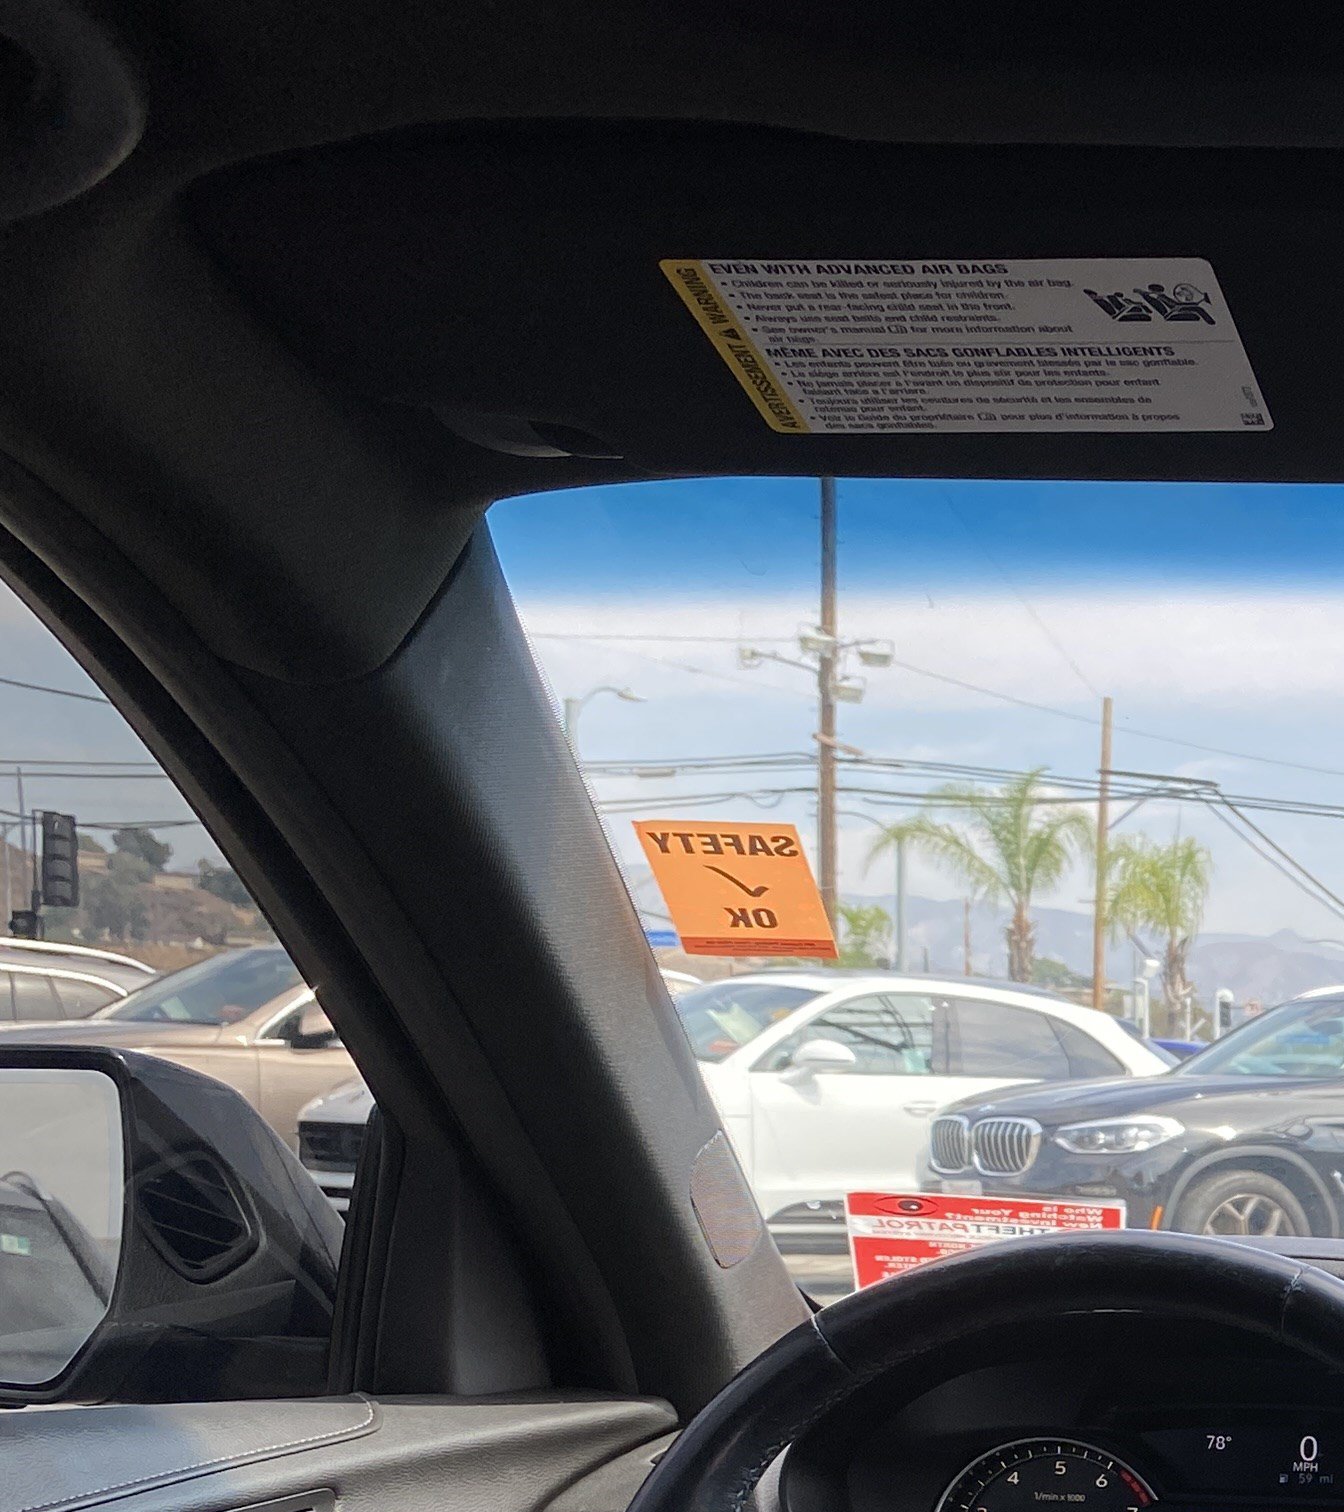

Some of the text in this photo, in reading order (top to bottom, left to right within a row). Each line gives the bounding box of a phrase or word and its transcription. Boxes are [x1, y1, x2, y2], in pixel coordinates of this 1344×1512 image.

[708, 263, 1009, 275] EVEN WITH ADVANCED AIR BAGS
[731, 279, 783, 288] Children
[811, 280, 828, 288] be
[829, 279, 864, 288] killed
[883, 280, 937, 290] seriously
[940, 280, 983, 290] injured
[986, 280, 1002, 289] by
[1004, 280, 1025, 288] the
[1028, 279, 1044, 287] air
[676, 267, 730, 325] WARNING
[765, 346, 1175, 358] MÊME AVEC DES SACS GONFLABLES INTELLIGENTS
[1206, 1435, 1233, 1450] 78°
[1299, 1435, 1319, 1462] 0
[1054, 1461, 1067, 1475] 5
[1292, 1462, 1319, 1473] MPH
[1006, 1471, 1020, 1485] 4
[1095, 1474, 1108, 1488] 6
[1298, 1474, 1334, 1484] 59 mi
[1034, 1492, 1059, 1502] 1/min
